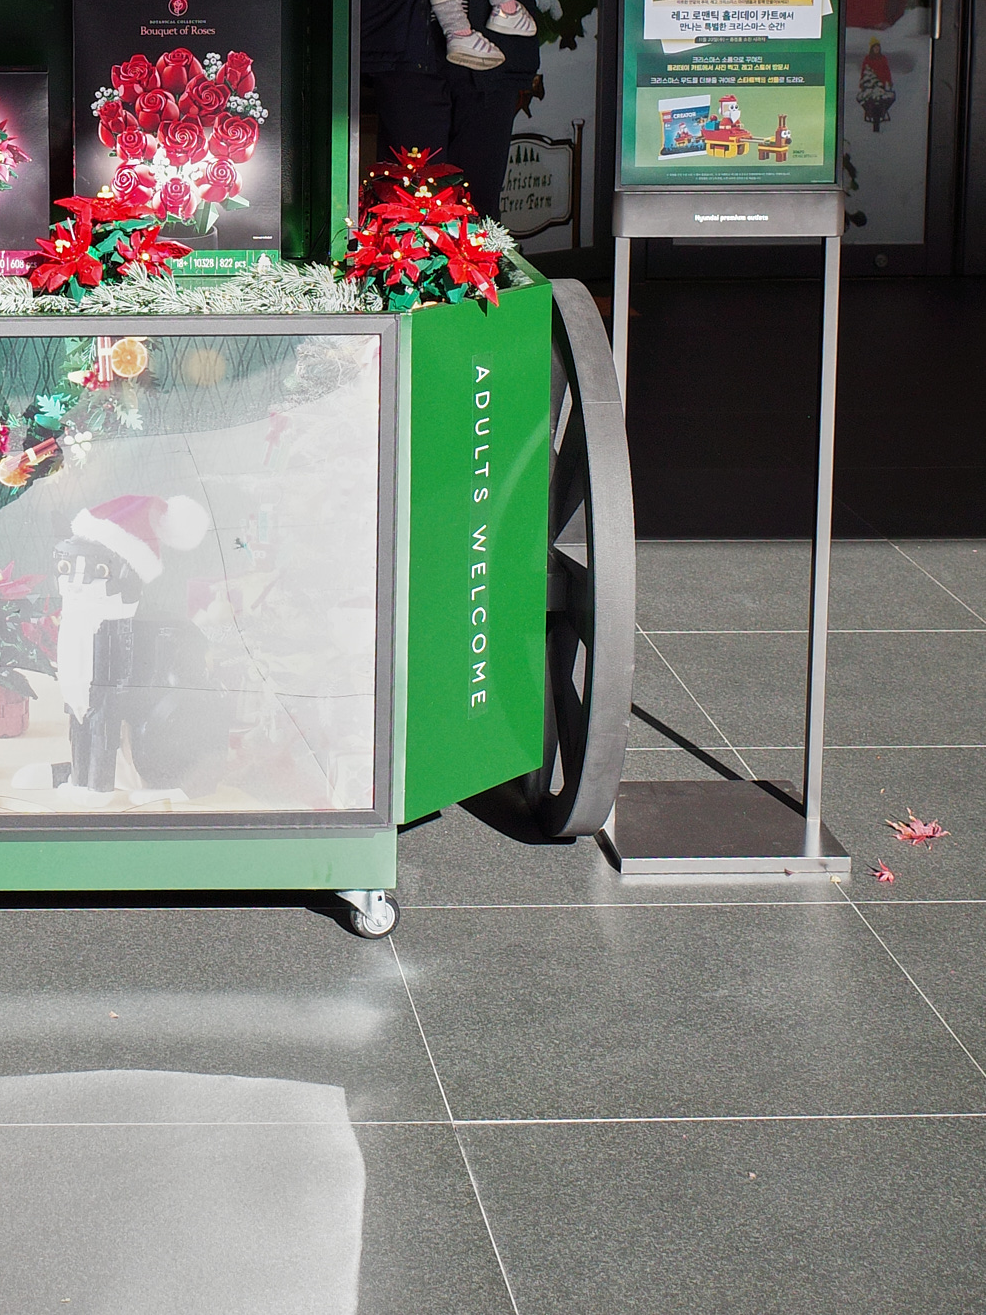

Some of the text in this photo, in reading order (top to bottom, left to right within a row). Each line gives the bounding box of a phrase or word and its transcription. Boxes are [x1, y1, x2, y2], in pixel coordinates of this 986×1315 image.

[671, 10, 794, 21] 레고 로맨틱 홀리데이 카트에서
[140, 25, 216, 37] Bouquet of Roses
[679, 22, 786, 31] 만나는 특별한 크리스마스 순간!
[505, 169, 553, 192] hristmas
[501, 193, 552, 213] Tree Farm
[10, 259, 25, 269] 608
[175, 258, 247, 269] 18+ 10328 822 pcs
[470, 365, 490, 708] ADULTS WELCOME
